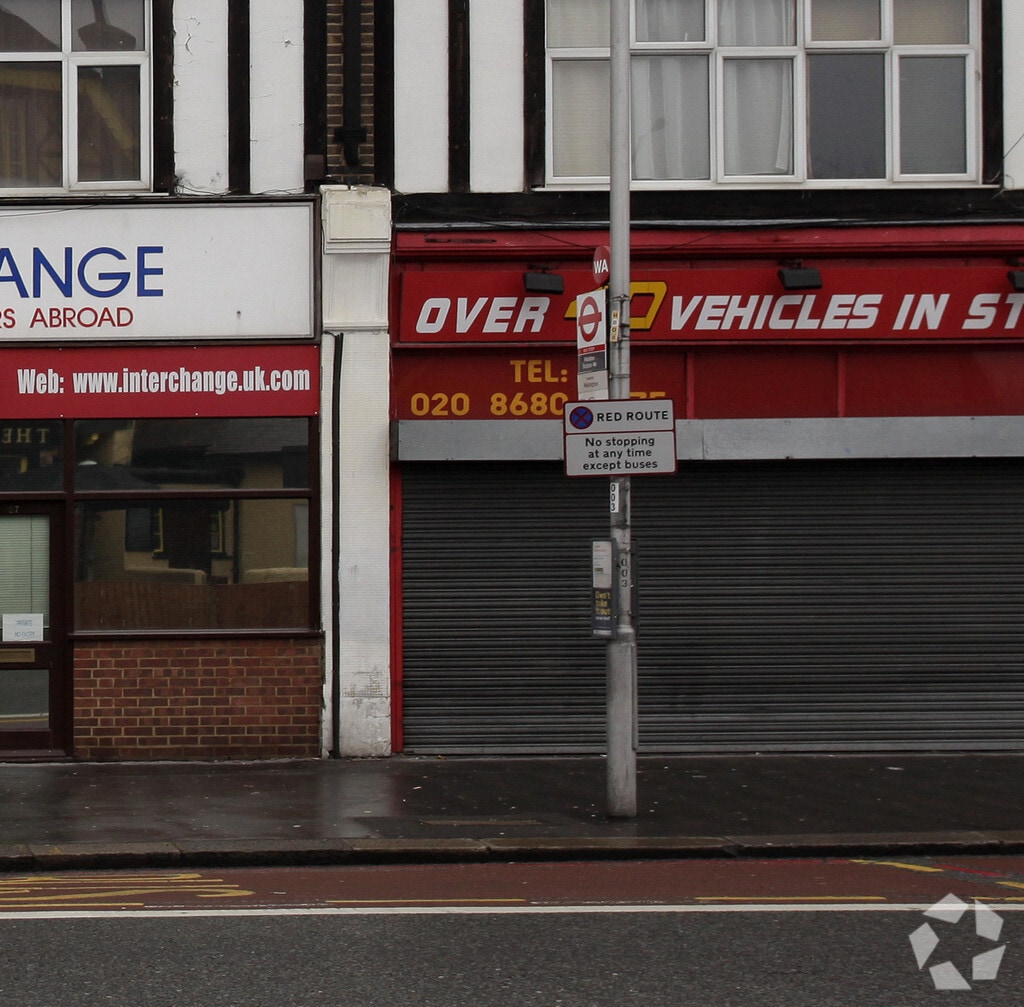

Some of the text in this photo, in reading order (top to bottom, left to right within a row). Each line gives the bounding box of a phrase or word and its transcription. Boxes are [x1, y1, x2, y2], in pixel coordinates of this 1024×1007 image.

[593, 259, 609, 274] WA
[415, 296, 551, 334] OVER
[564, 281, 668, 330] 0
[670, 294, 883, 330] VEHICLES
[892, 293, 950, 330] IN
[29, 307, 134, 328] ABROAD
[510, 359, 568, 383] TEL:
[17, 366, 311, 395] Web: www.interchange.uk.com
[410, 391, 569, 416] 020 8680
[597, 411, 669, 422] RED ROUTE
[585, 437, 655, 447] No stopping
[588, 449, 652, 459] at any time
[583, 460, 658, 471] except buses
